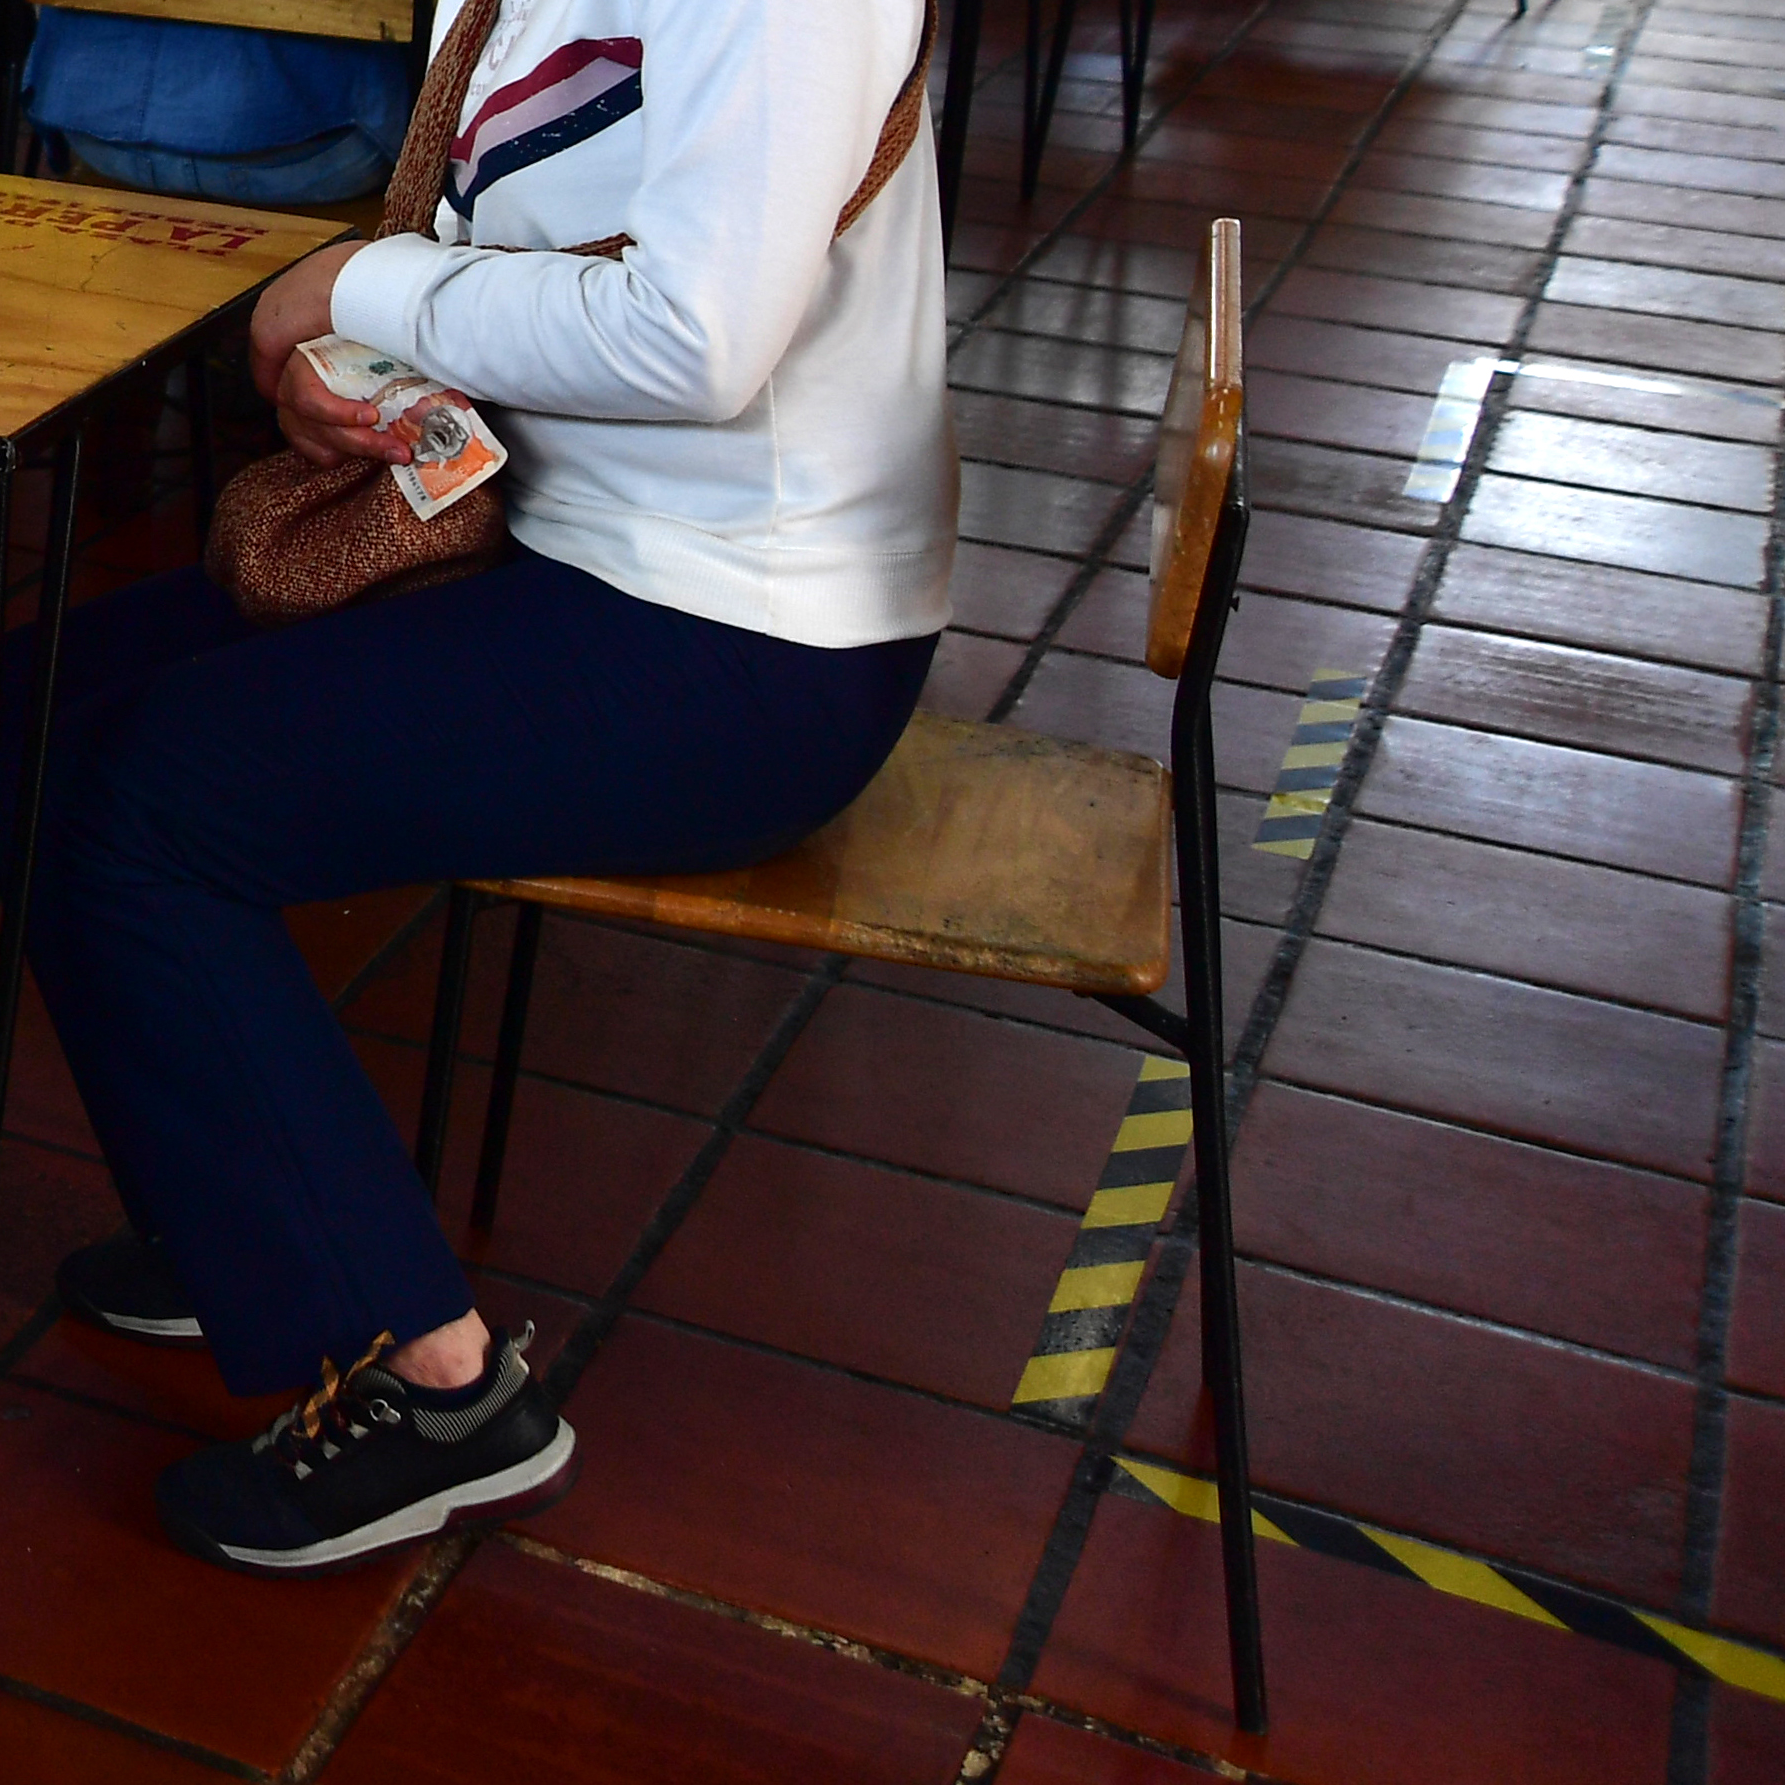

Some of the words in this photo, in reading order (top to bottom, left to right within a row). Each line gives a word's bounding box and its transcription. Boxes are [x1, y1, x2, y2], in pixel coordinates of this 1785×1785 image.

[92, 205, 270, 236] DESDE
[52, 226, 230, 257] PLAZA
[167, 225, 255, 251] LA
